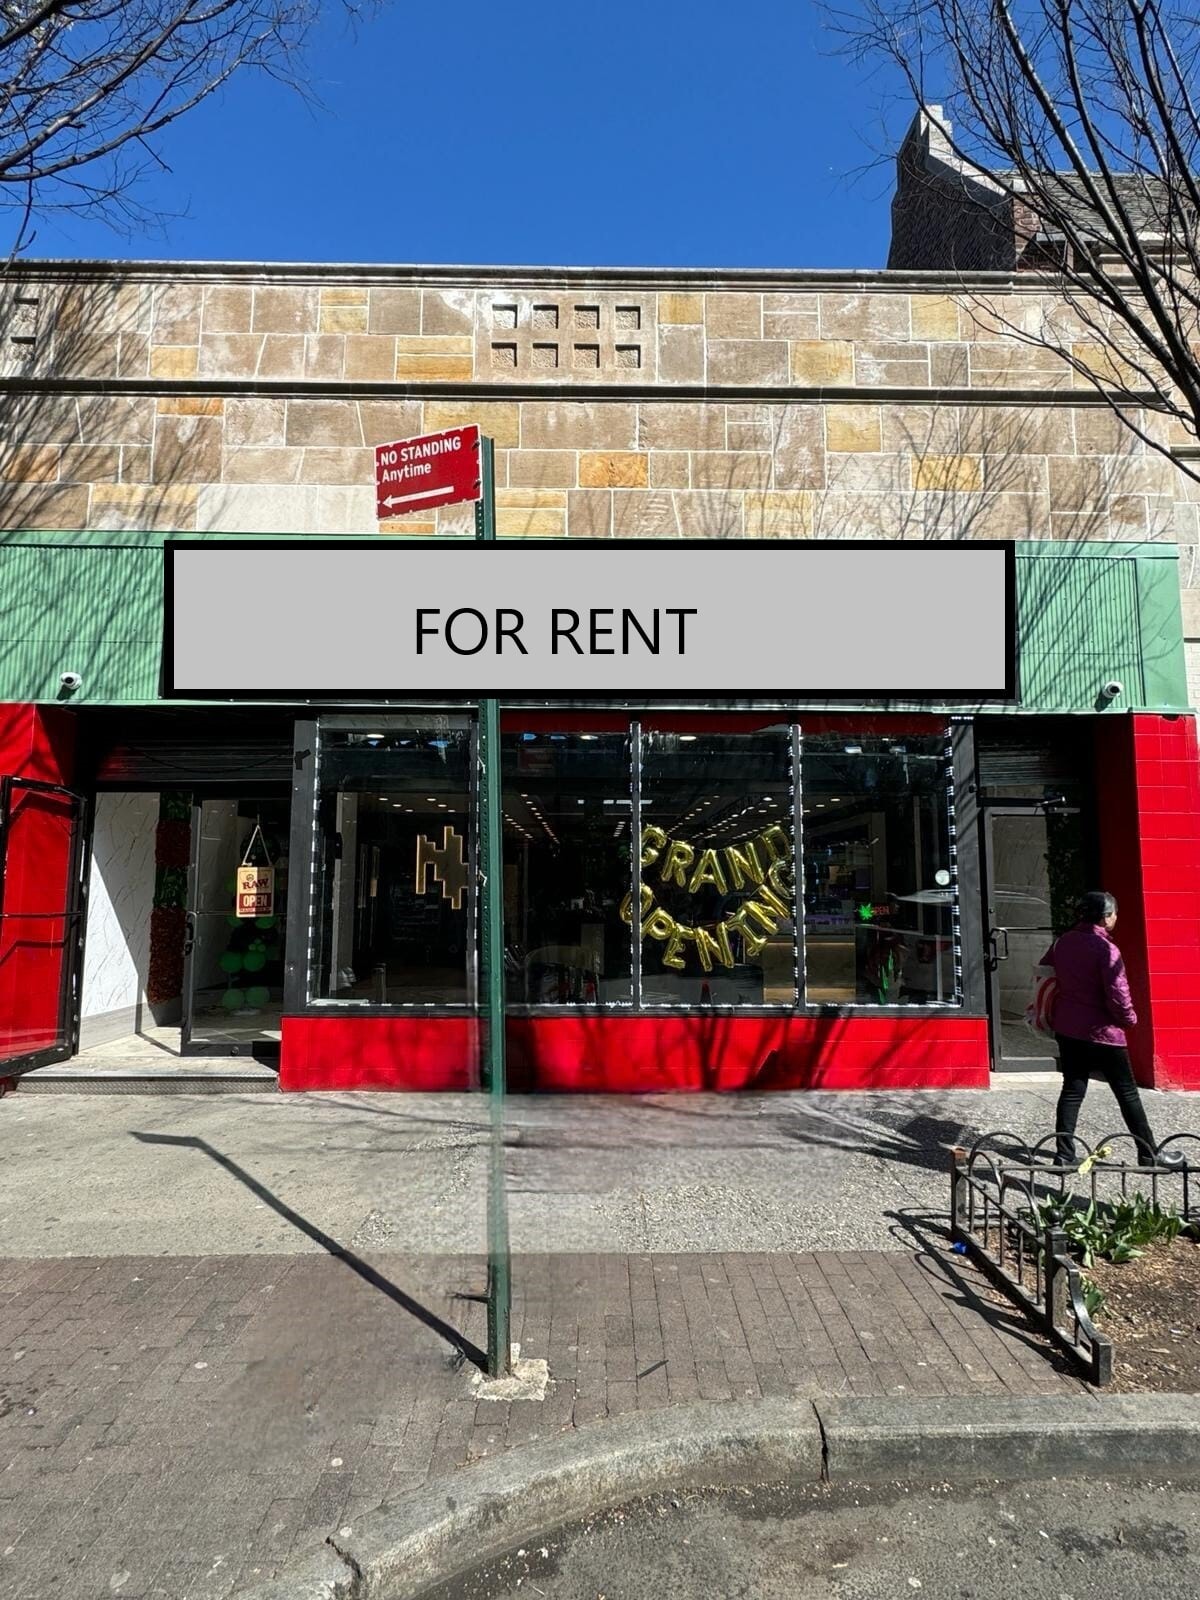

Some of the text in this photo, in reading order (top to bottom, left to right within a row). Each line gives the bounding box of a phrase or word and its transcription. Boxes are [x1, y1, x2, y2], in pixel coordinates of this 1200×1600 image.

[380, 436, 461, 466] NO STANDING
[382, 462, 432, 483] Anytime
[640, 824, 792, 896] GRAND
[242, 878, 269, 890] RAW
[243, 894, 268, 907] OPEN
